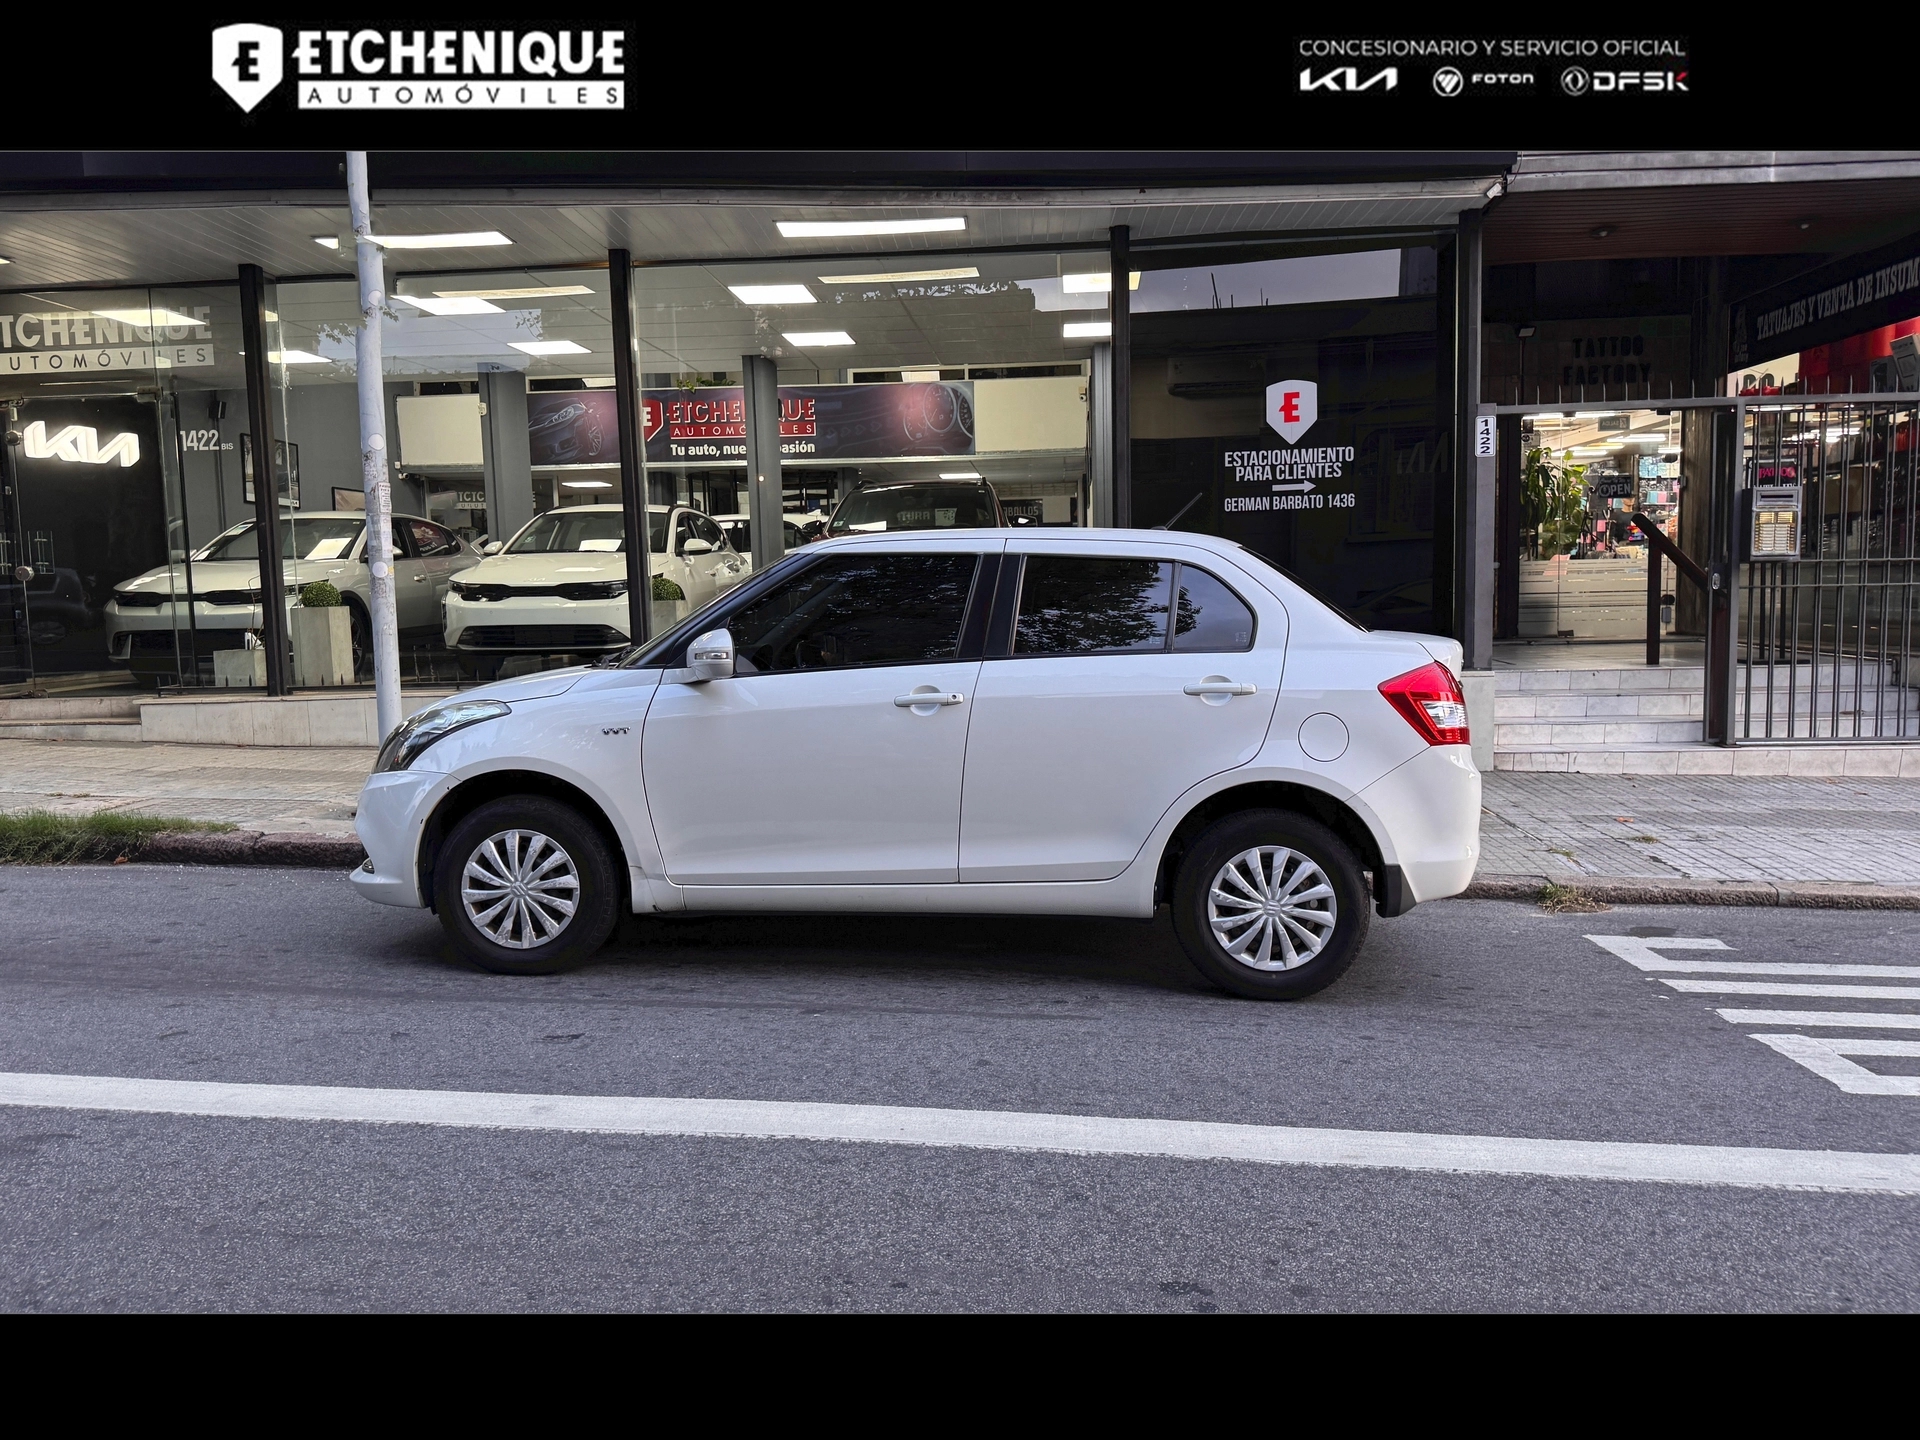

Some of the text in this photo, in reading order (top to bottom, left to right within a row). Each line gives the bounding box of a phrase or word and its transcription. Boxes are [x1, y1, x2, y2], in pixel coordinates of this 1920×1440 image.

[1757, 256, 1920, 340] TATUAJES Y VENTA DE INSUM
[1573, 335, 1643, 359] TATTOO
[1564, 363, 1651, 385] FACTORY
[666, 398, 816, 424] ETCHEUE
[1279, 392, 1300, 423] E
[180, 429, 219, 451] 1422
[673, 424, 812, 436] AUTOMÓLES
[1480, 419, 1491, 454] 1422
[23, 421, 140, 467] KIA
[670, 441, 816, 457] Tu auto, nue asión
[1224, 446, 1355, 467] ESTACIONAMIENTO
[1235, 462, 1342, 482] PARA CLIENTES
[1599, 483, 1631, 497] OPEN
[1224, 493, 1356, 512] GERMAN BARBATO 1436
